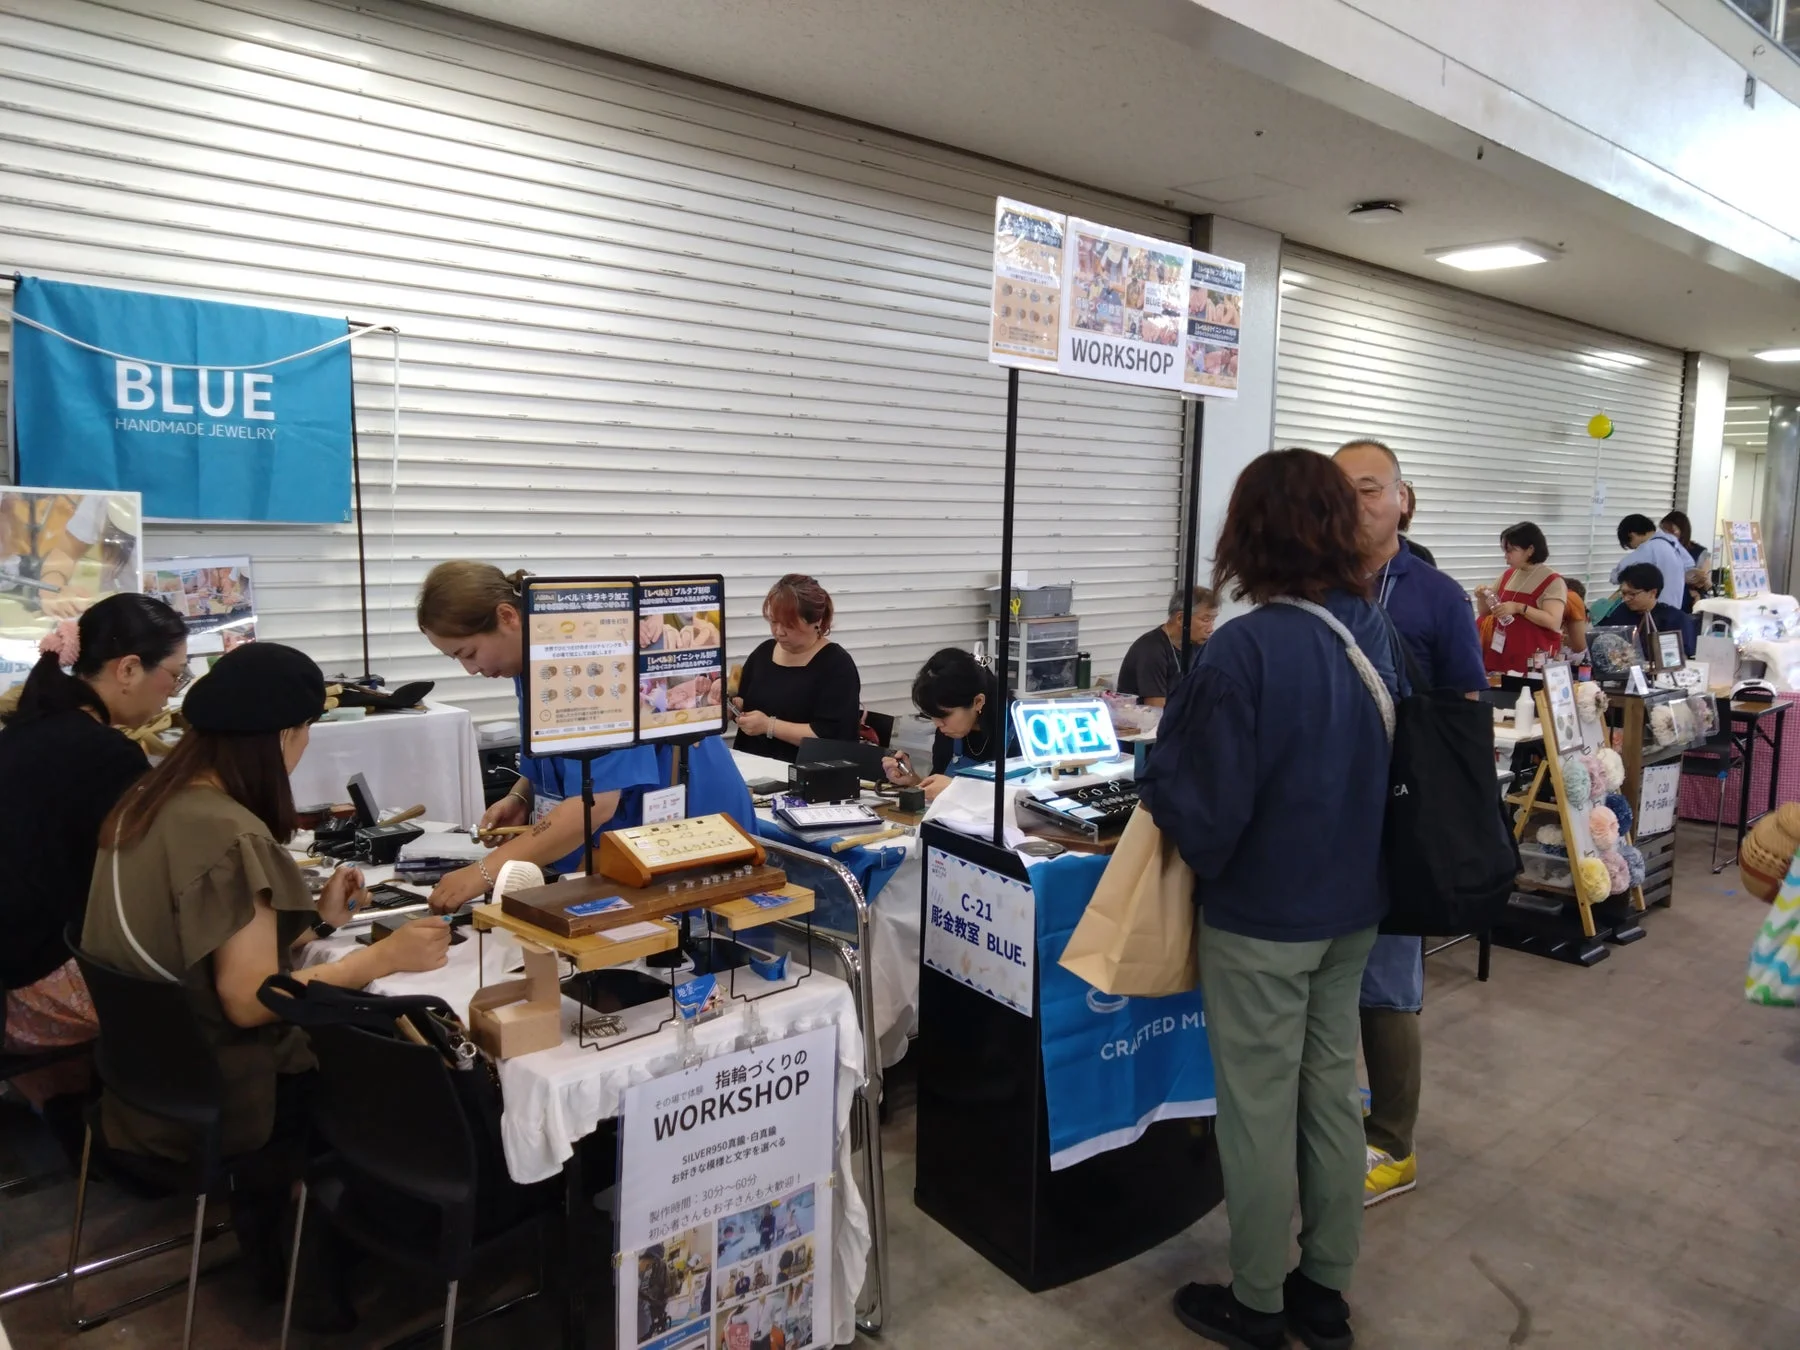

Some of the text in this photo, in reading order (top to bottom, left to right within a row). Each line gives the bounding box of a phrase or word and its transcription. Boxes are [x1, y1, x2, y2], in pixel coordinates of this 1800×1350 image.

[1071, 337, 1174, 375] WORKSHOP
[115, 360, 277, 420] BLUE
[115, 418, 277, 441] HANDMADE JEWELRY
[1027, 711, 1111, 750] OPEN
[961, 893, 993, 922] C-21
[931, 905, 1026, 967] 彫金教室 BLUE.
[1100, 1016, 1175, 1060] CRAFTED
[715, 1050, 808, 1090] 指輪づくりの
[653, 1070, 810, 1142] WORKSHOP
[655, 1085, 704, 1110] その場で体験
[671, 1137, 786, 1184] お好きな模様と文字を選べる
